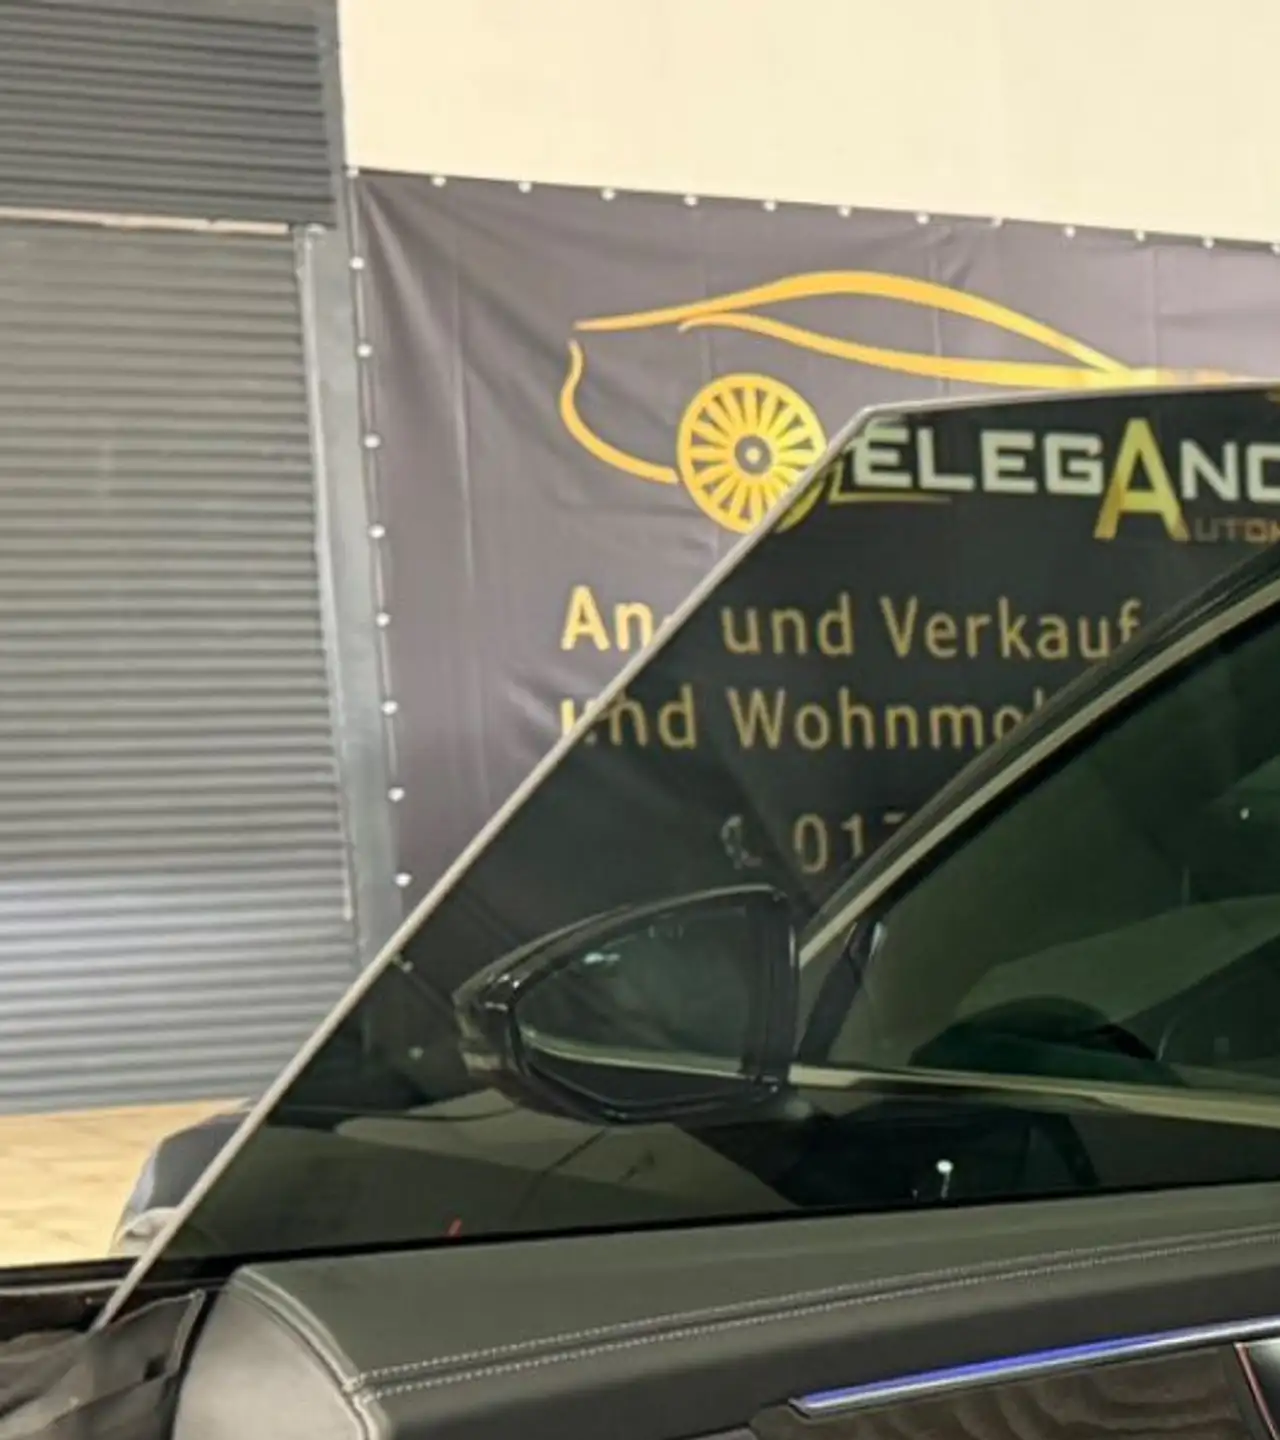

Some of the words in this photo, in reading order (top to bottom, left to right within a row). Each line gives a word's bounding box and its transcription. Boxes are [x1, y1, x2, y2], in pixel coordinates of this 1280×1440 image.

[560, 584, 672, 652] An
[721, 592, 853, 657] und
[879, 593, 1143, 659] Verkauf
[727, 686, 1044, 750] Wohnmo
[793, 812, 906, 874] 01
